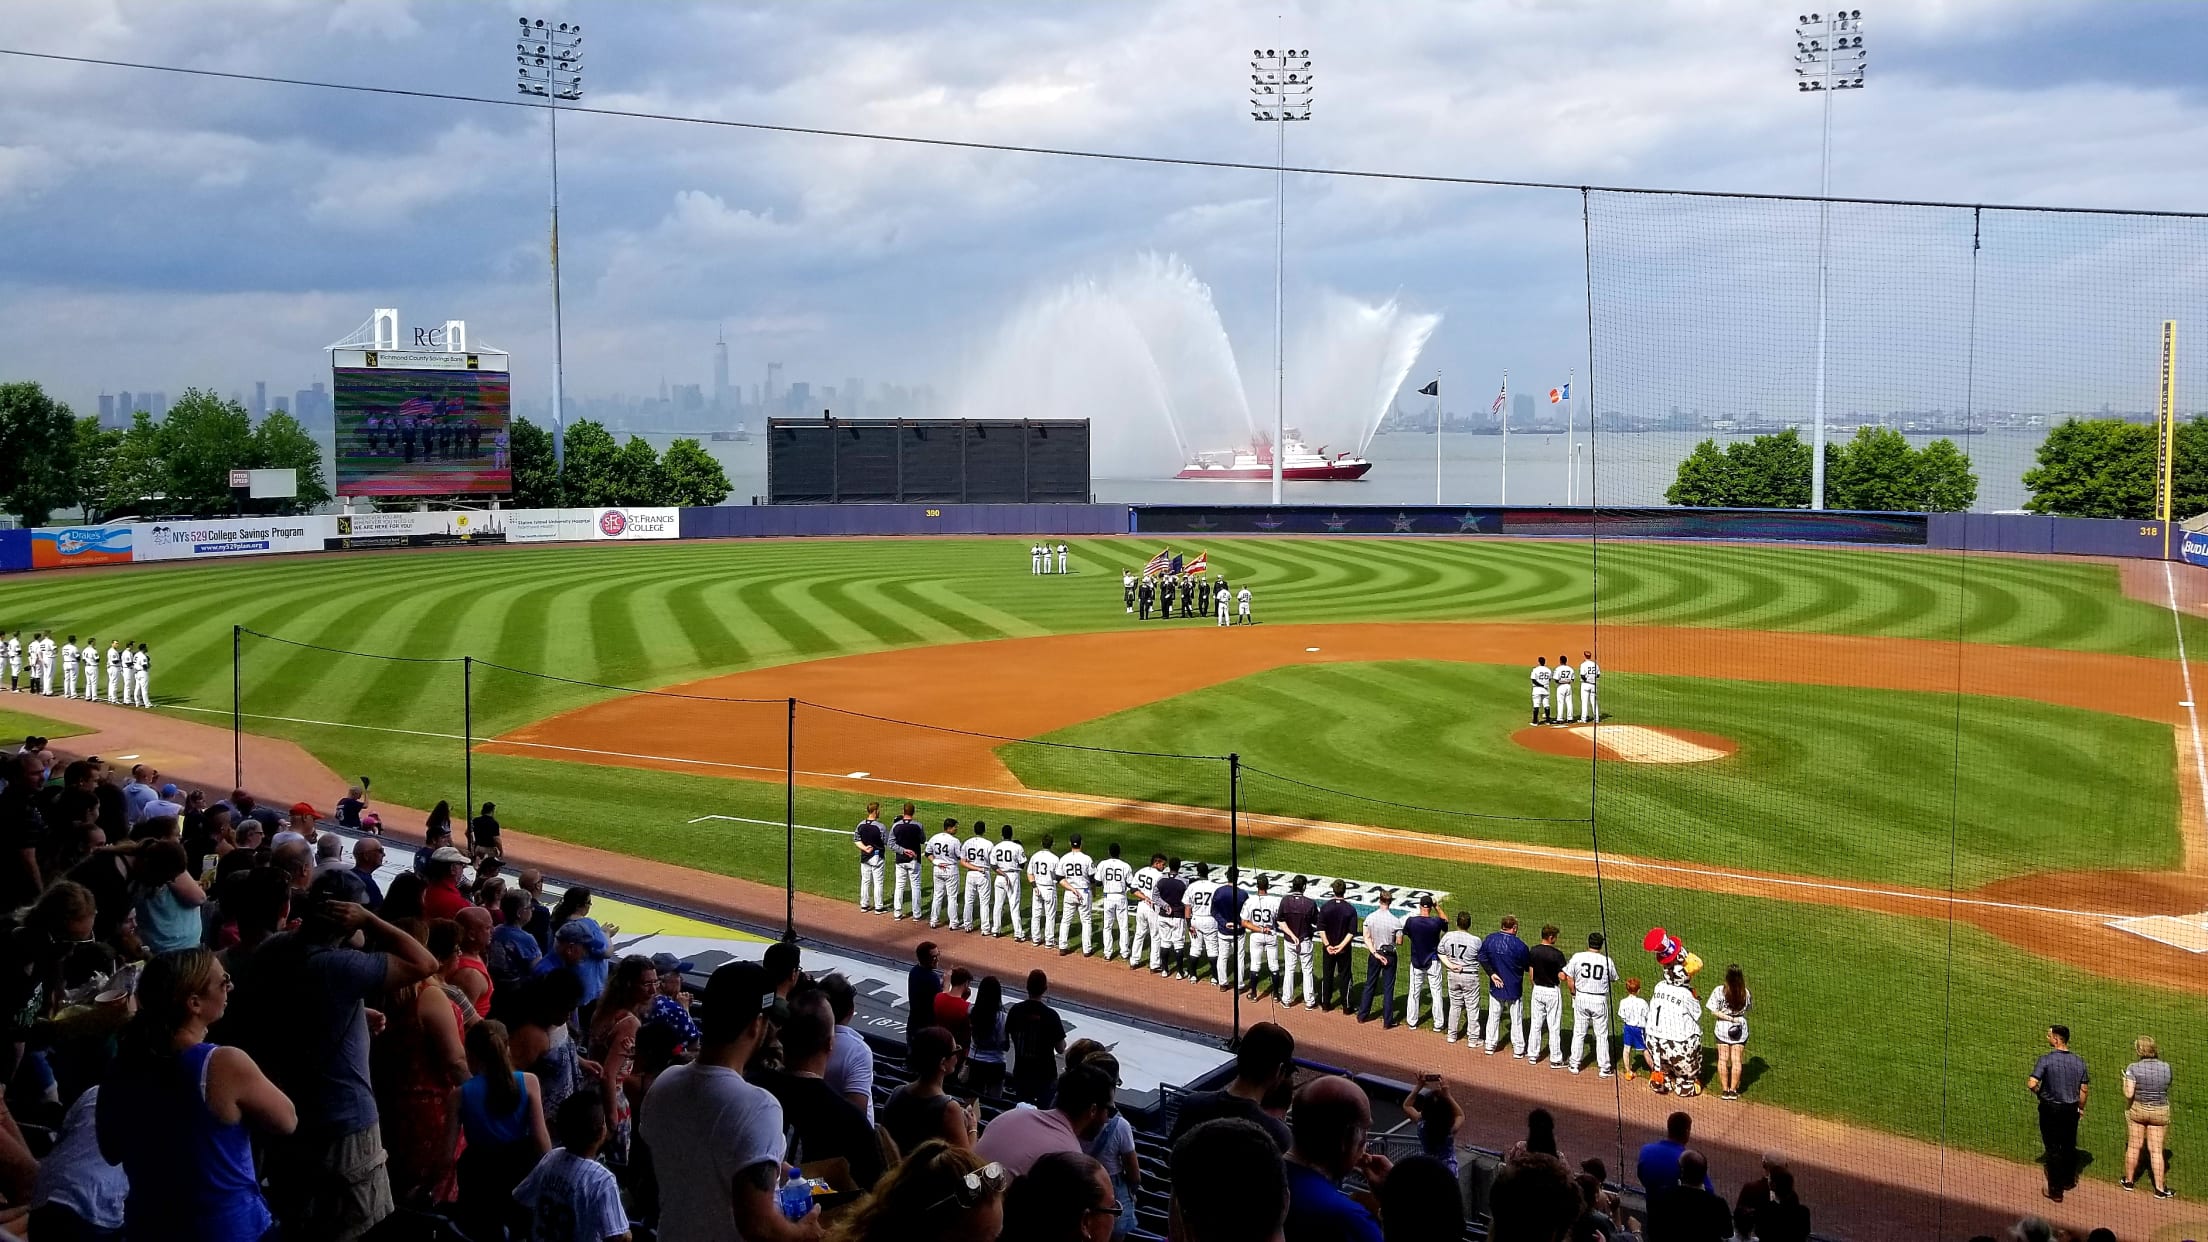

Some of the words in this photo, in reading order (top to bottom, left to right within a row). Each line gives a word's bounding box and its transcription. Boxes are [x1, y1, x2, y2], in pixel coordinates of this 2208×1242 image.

[71, 531, 100, 540] Drake's
[191, 531, 207, 541] 529
[208, 530, 237, 541] College
[240, 528, 269, 540] Savings
[272, 527, 304, 538] Program
[2140, 527, 2157, 536] 318
[934, 842, 949, 857] 34
[968, 848, 984, 861] 64
[996, 850, 1012, 862] 20
[1035, 862, 1047, 875] 13
[1066, 863, 1082, 876] 28
[1106, 868, 1122, 881] 66
[1138, 875, 1153, 890] 59
[1195, 892, 1212, 906] 27
[1253, 908, 1271, 923] 63
[1450, 944, 1467, 960] 17
[1581, 962, 1603, 981] 30
[1656, 1005, 1661, 1026] 1
